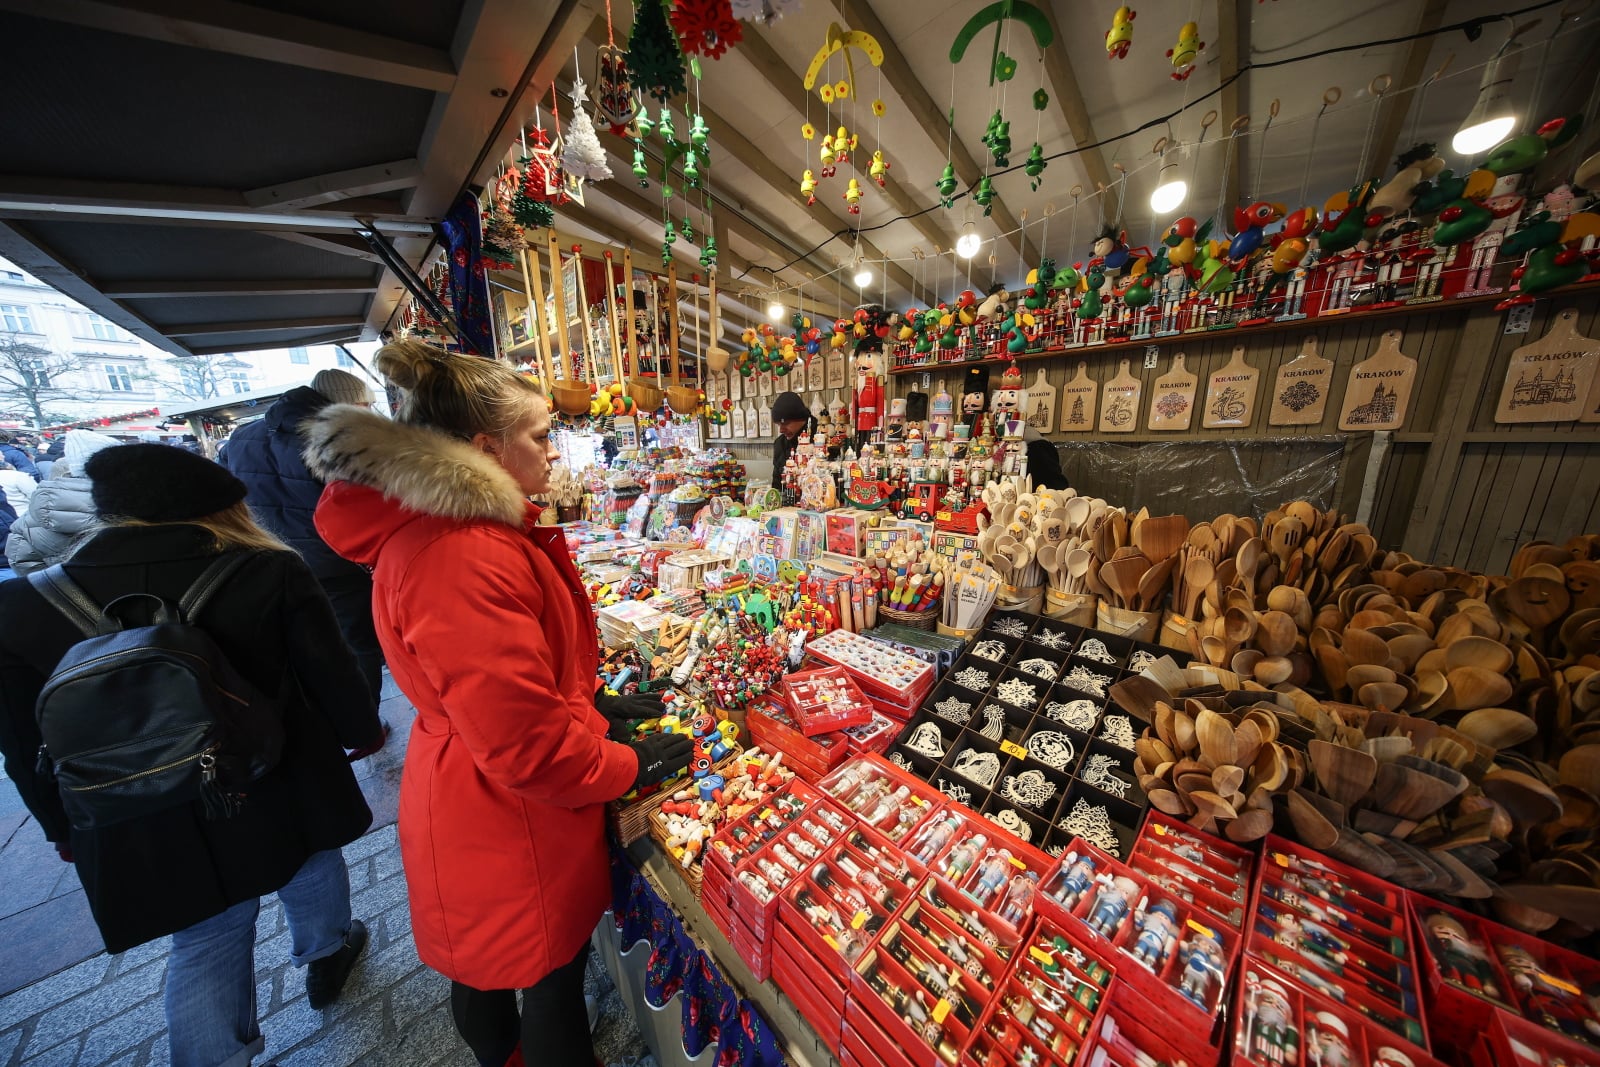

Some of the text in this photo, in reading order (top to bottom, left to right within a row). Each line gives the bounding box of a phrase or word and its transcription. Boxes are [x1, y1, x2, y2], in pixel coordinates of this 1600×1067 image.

[1524, 350, 1587, 362] KRAKÓW
[1283, 368, 1325, 378] KRAKÓW
[1356, 369, 1405, 380] KRAKÓW
[1215, 374, 1253, 383] KRAKÓW
[1107, 385, 1137, 393] KRAKÓW
[1159, 381, 1192, 389] KRAKÓW
[1067, 386, 1093, 394] KRAKÓW
